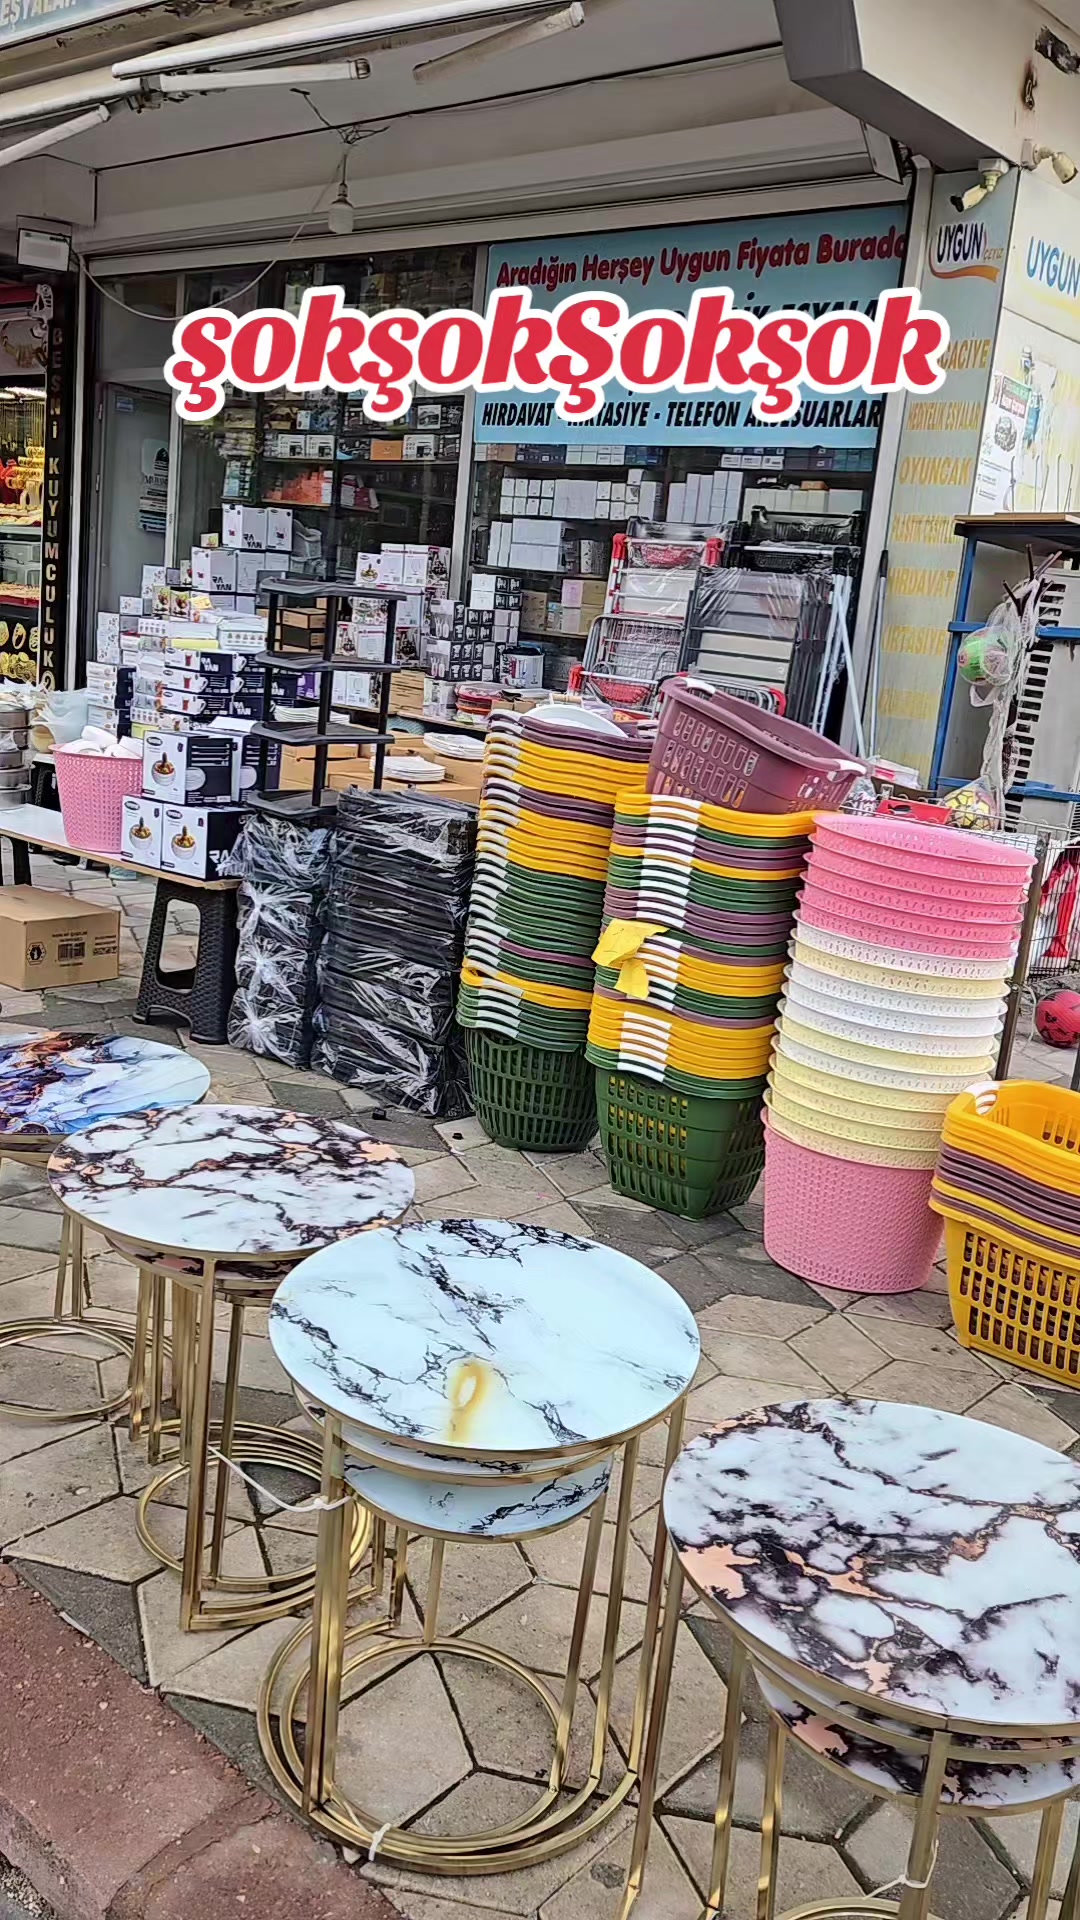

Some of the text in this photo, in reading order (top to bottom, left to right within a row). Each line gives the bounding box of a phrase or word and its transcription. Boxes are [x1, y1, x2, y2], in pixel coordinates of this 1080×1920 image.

[936, 222, 984, 264] UYGUN
[496, 254, 577, 293] Aradığın
[582, 250, 655, 287] Herşey
[660, 246, 731, 284] Uygun
[737, 236, 810, 278] Fiyata
[481, 402, 555, 427] HIRDAVAT
[666, 401, 741, 427] TELEFON
[899, 457, 972, 485] OYUNCAK
[43, 457, 60, 668] KUYUMCULUK
